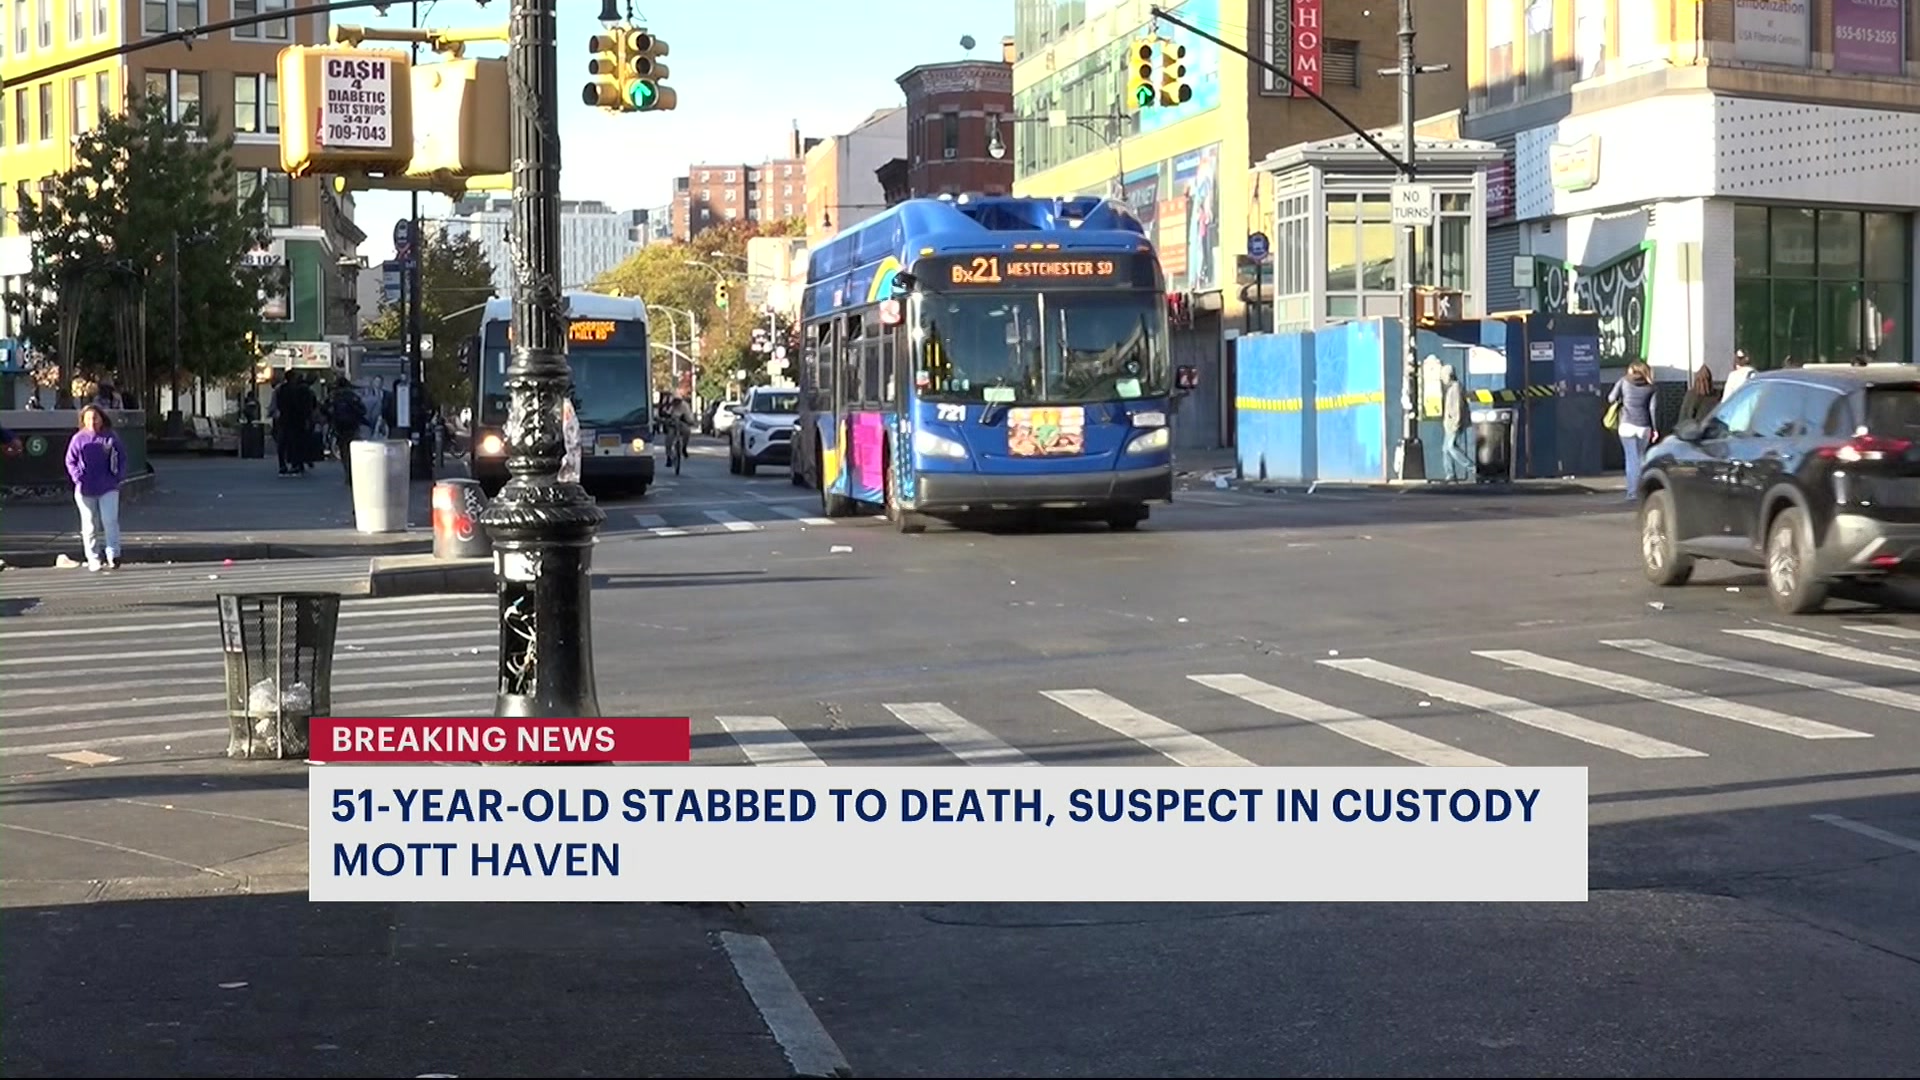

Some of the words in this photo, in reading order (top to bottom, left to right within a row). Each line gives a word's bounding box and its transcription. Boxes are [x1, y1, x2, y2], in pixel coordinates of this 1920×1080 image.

[1836, 25, 1897, 44] 855-615-2555
[1274, 0, 1287, 90] WORKING
[351, 79, 362, 90] 4
[328, 89, 385, 103] DIABETIC
[328, 103, 350, 114] TEST
[352, 104, 386, 116] STRIPS
[343, 115, 371, 124] 347
[328, 124, 386, 141] 709-7043
[1403, 190, 1420, 203] NO
[1395, 206, 1429, 219] TURNS
[951, 256, 1002, 284] Bx21
[1007, 261, 1093, 276] WESTCHESTER
[936, 403, 967, 422] 721
[32, 439, 41, 452] 5
